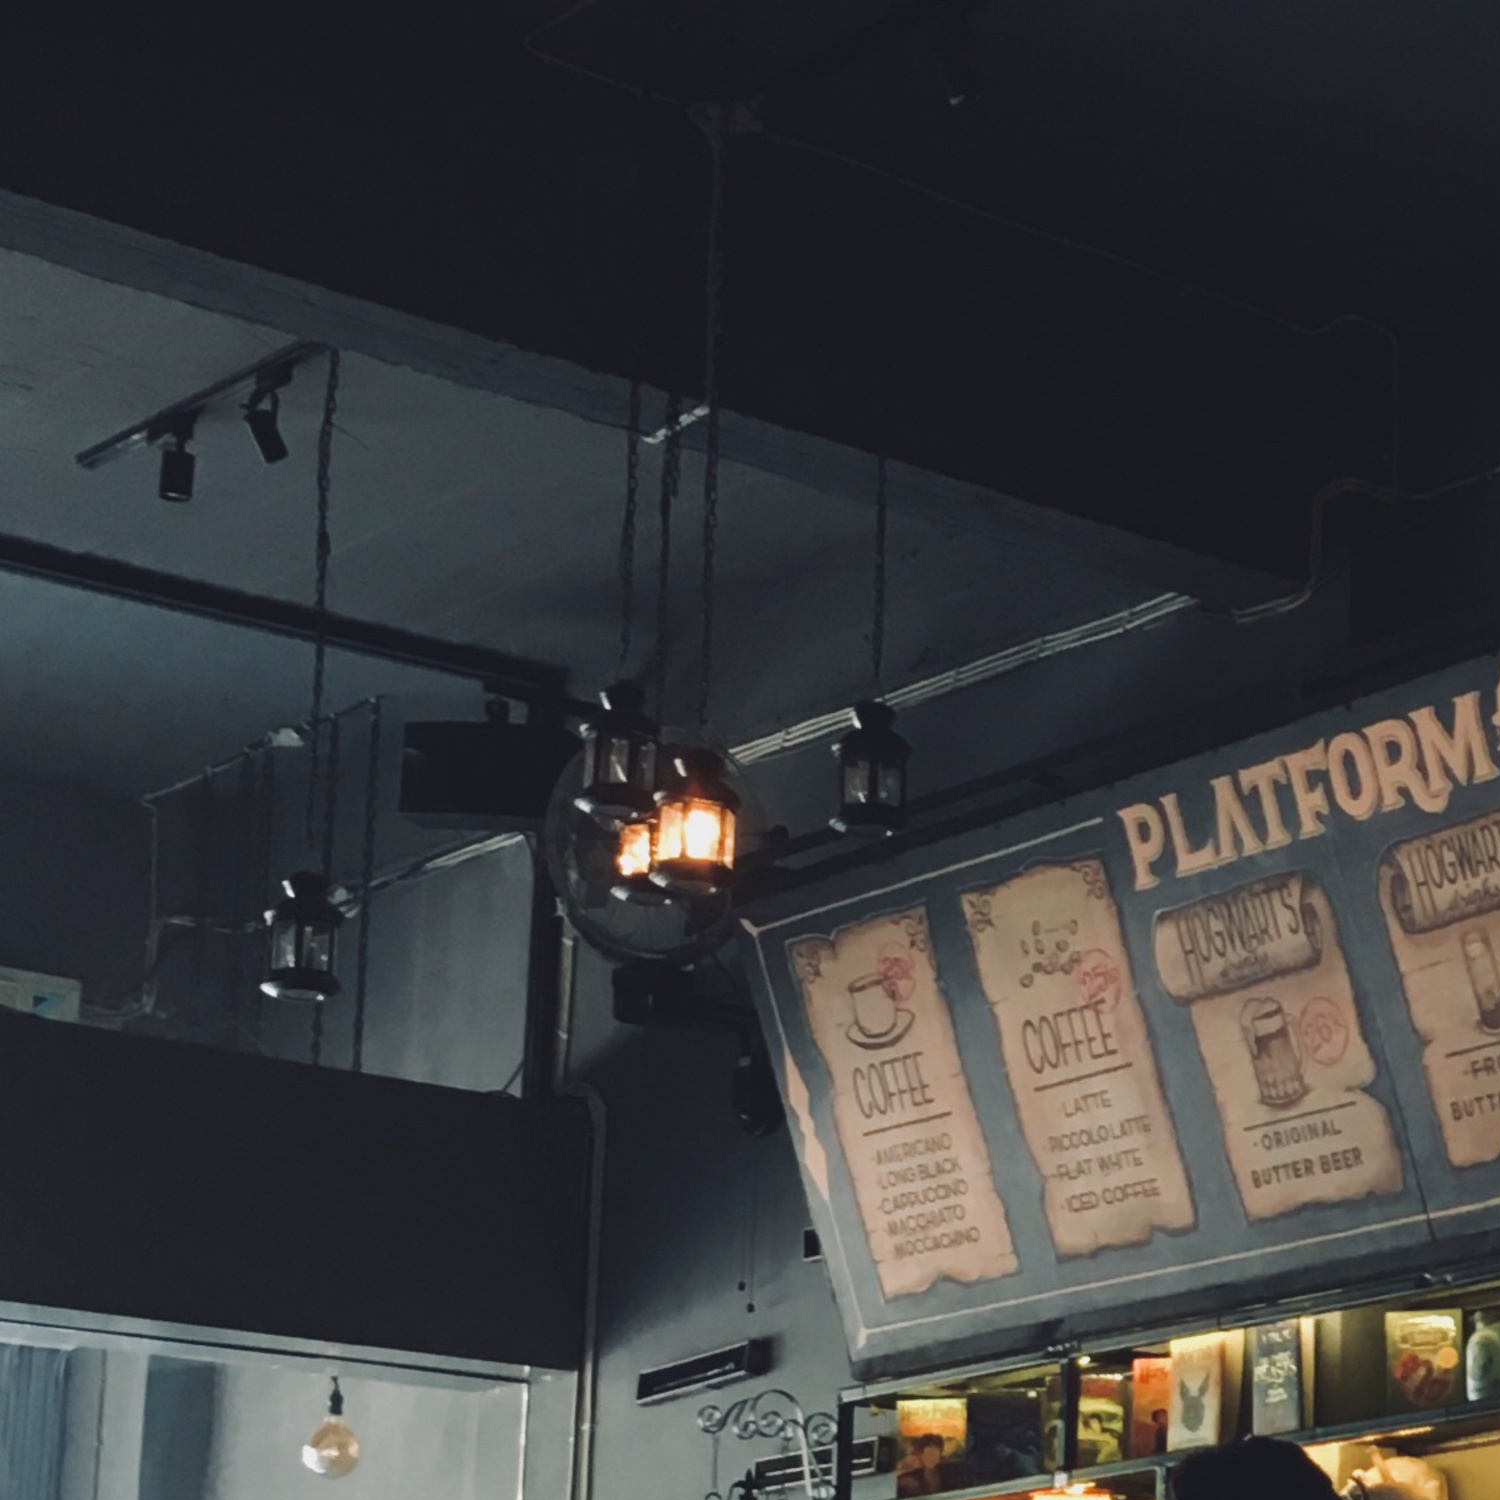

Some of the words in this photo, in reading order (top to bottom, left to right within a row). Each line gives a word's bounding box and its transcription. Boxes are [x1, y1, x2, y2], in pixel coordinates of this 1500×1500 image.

[1117, 691, 1500, 892] PLATFORM
[1022, 997, 1118, 1075] COFFEE
[852, 1051, 935, 1119] COFFEE
[1063, 1090, 1113, 1117] LATTE
[876, 1132, 953, 1165] AMERICANO
[1048, 1124, 1110, 1154] PICCOLO
[1113, 1114, 1152, 1141] LATTE
[1260, 1118, 1342, 1151] ORIGINAL
[917, 1156, 963, 1180] BLACK
[1056, 1157, 1094, 1182] FLAT
[1098, 1148, 1143, 1175] WHITE
[1251, 1157, 1315, 1189] BUTTER
[1320, 1146, 1364, 1175] BEER
[1065, 1190, 1099, 1213] ICED
[1103, 1178, 1161, 1205] COFFEE
